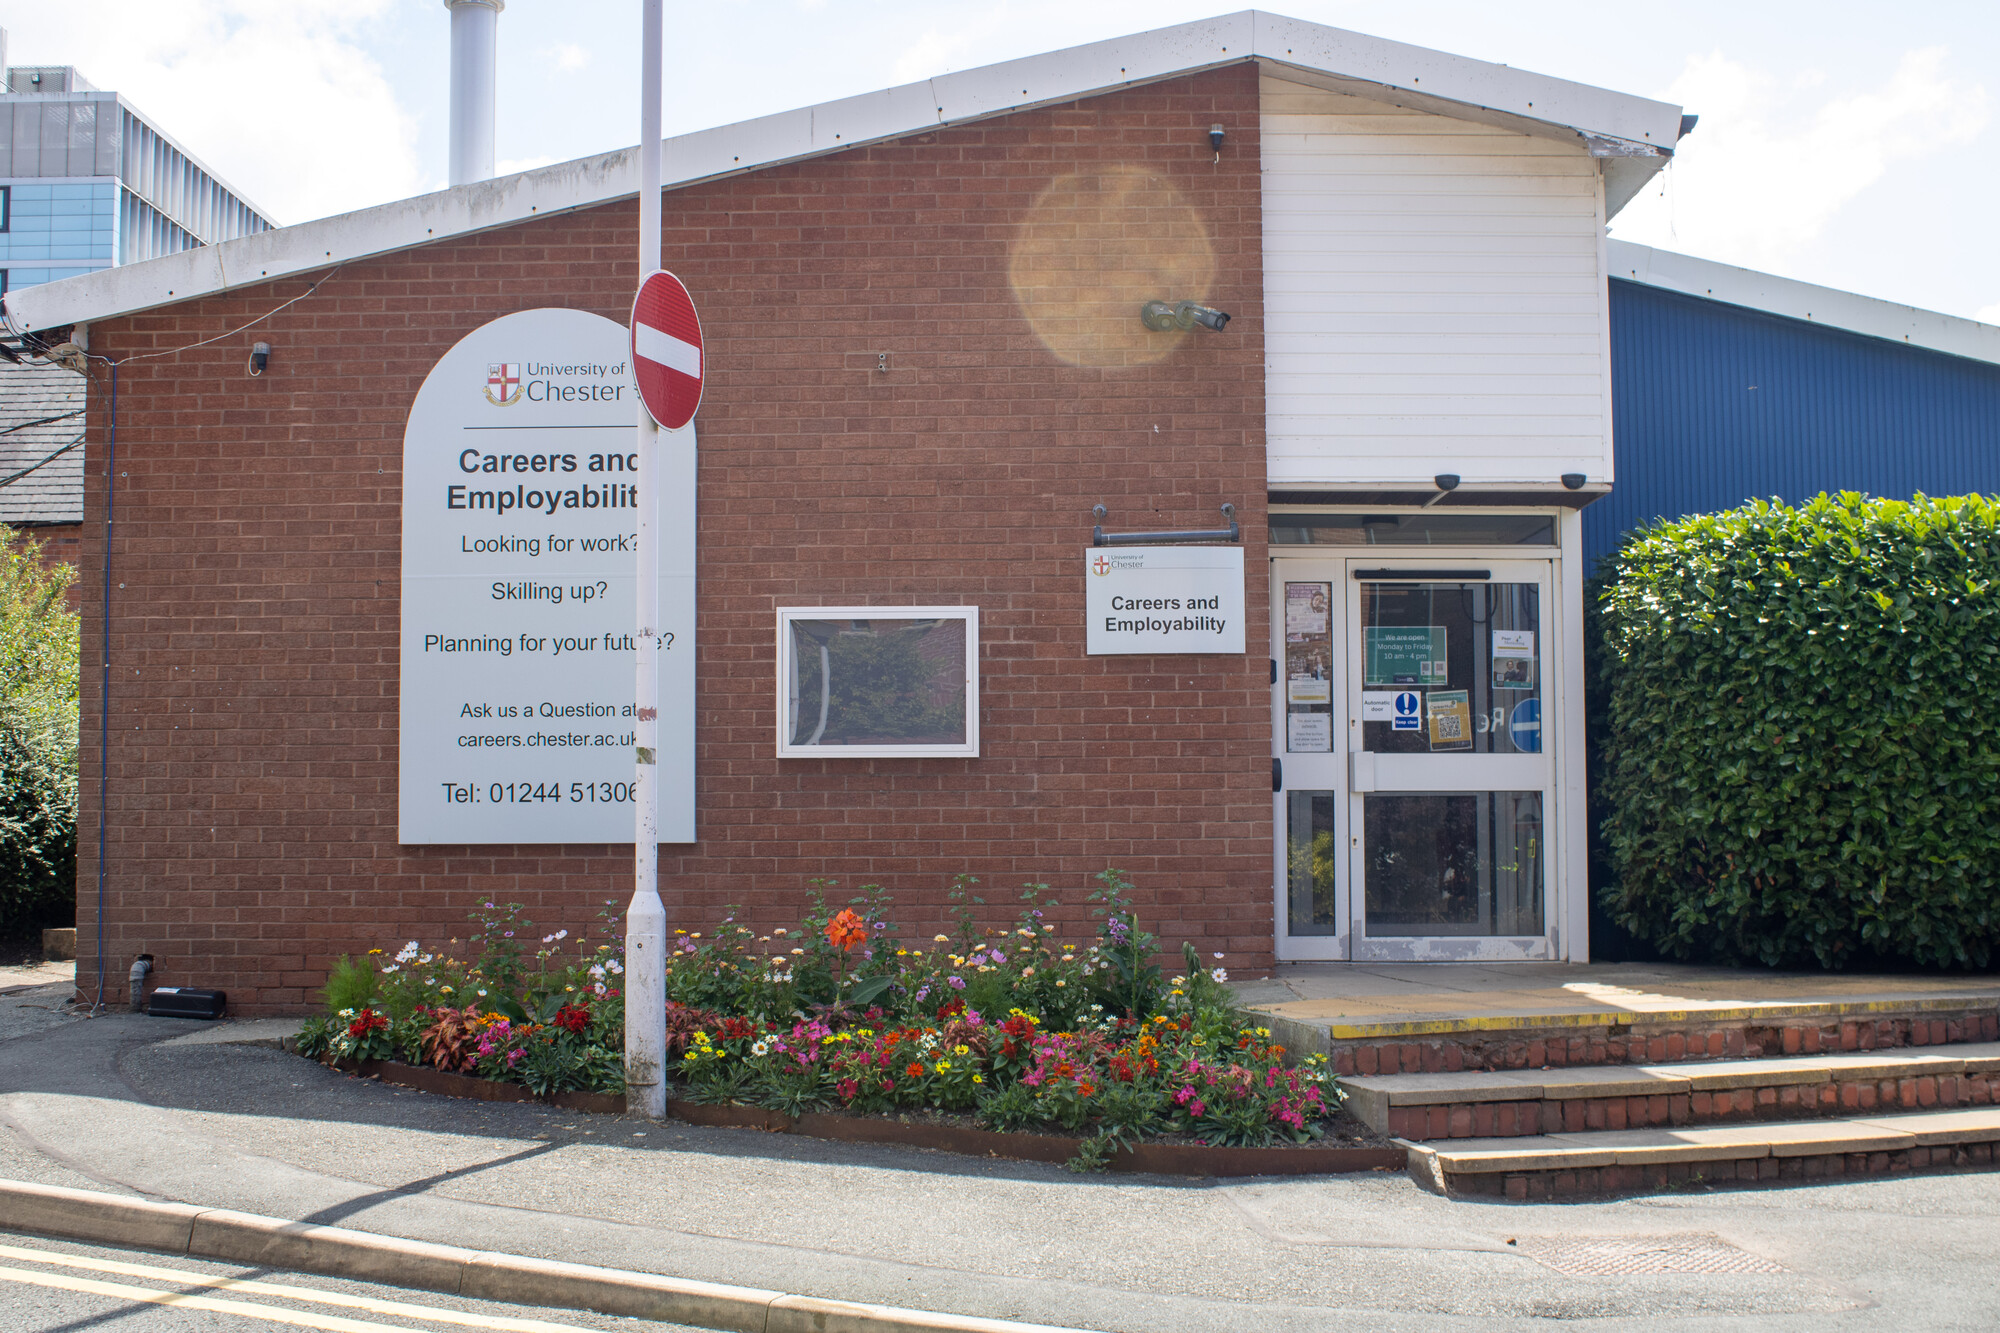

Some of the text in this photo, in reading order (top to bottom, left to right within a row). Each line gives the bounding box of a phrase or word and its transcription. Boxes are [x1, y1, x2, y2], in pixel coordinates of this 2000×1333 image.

[527, 361, 626, 378] University of
[526, 380, 626, 402] Chester
[459, 448, 578, 473] Careers
[447, 484, 638, 515] Employabilit
[461, 533, 638, 557] Looking for work?
[1111, 554, 1138, 562] University
[1111, 560, 1144, 569] Chester
[491, 581, 608, 604] Skilling up?
[1111, 595, 1219, 611] Careers and
[1105, 616, 1226, 635] Employability
[424, 632, 676, 656] Planning for your futu?
[1377, 643, 1403, 652] Monday
[1413, 643, 1433, 651] Friday
[460, 701, 638, 719] Ask us a Question at
[441, 783, 481, 803] Tel:
[489, 782, 562, 803] 01244
